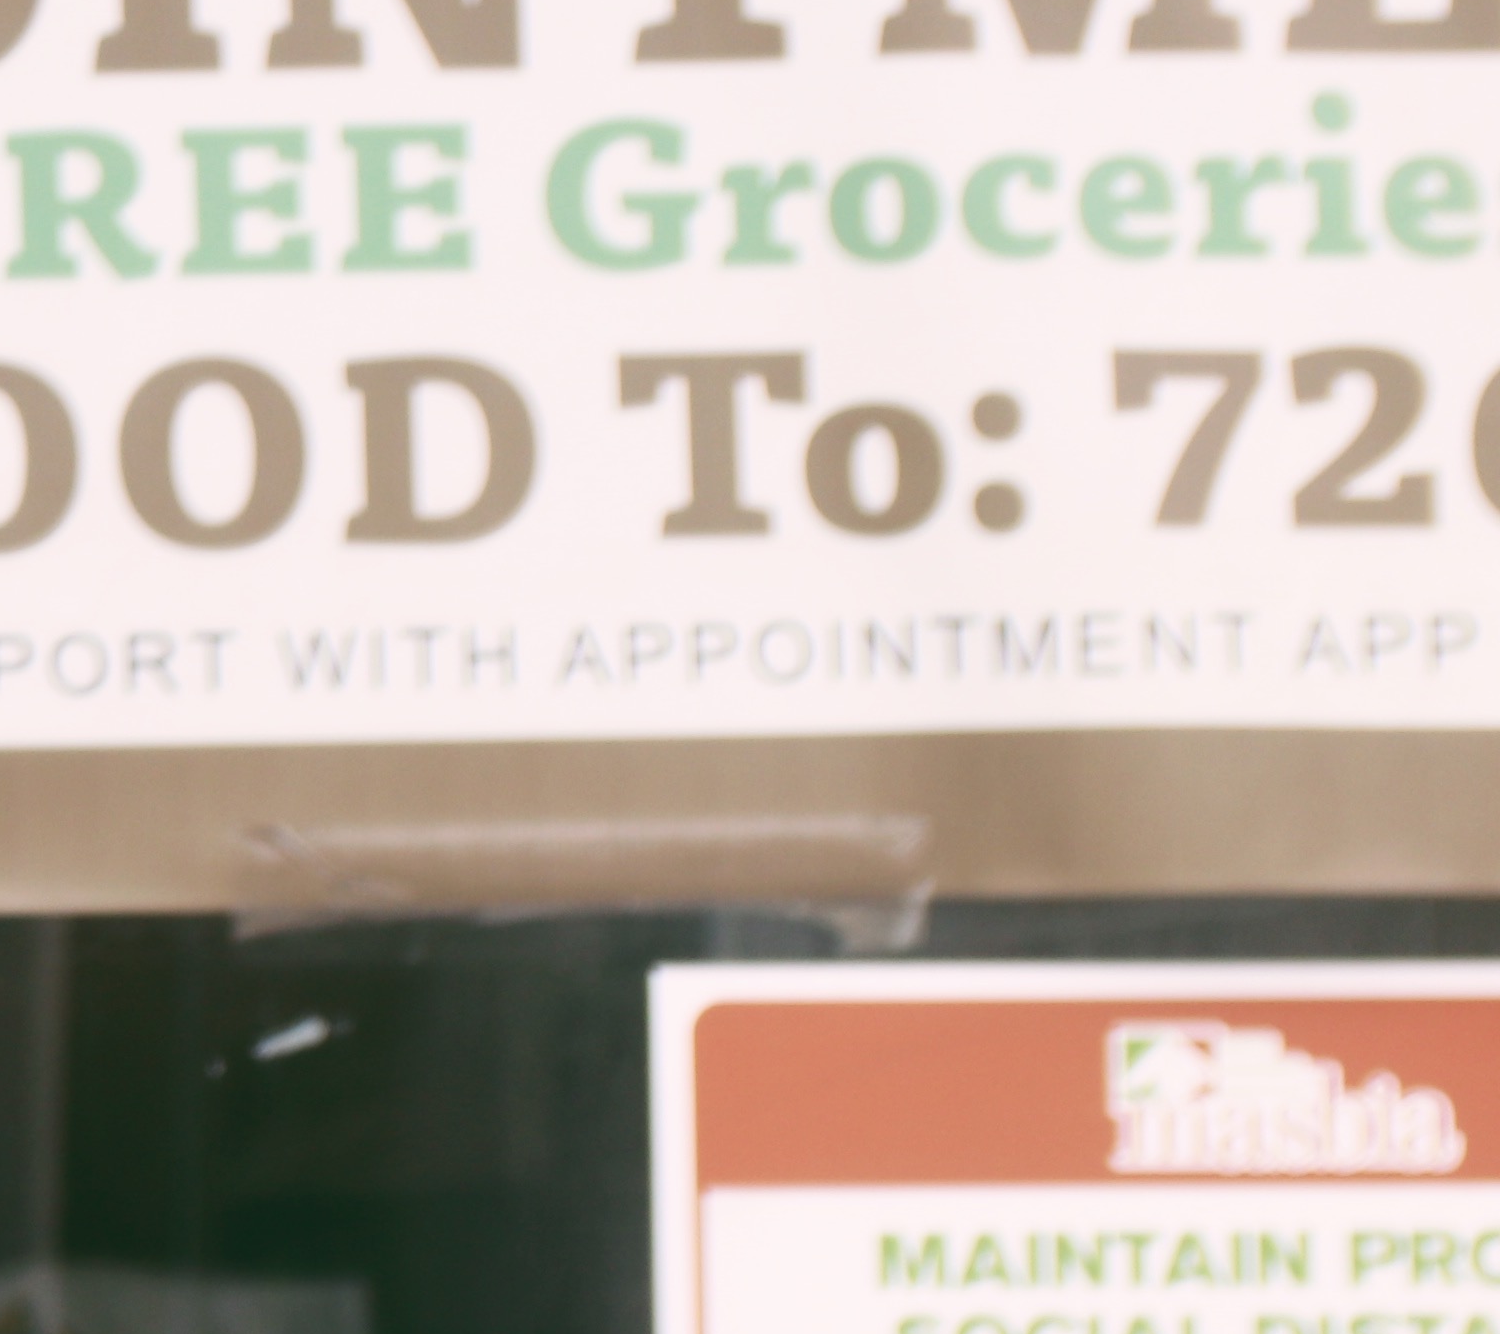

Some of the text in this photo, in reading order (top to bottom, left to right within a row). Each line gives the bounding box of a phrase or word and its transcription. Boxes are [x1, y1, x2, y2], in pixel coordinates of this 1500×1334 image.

[542, 91, 1500, 273] Grocerie
[616, 349, 1026, 540] To:
[1111, 344, 1500, 533] 72
[278, 625, 518, 691] WITH
[560, 611, 1257, 685] APPOINTMENT
[1298, 609, 1478, 675] APP
[877, 1230, 1310, 1287] MAINTAIN
